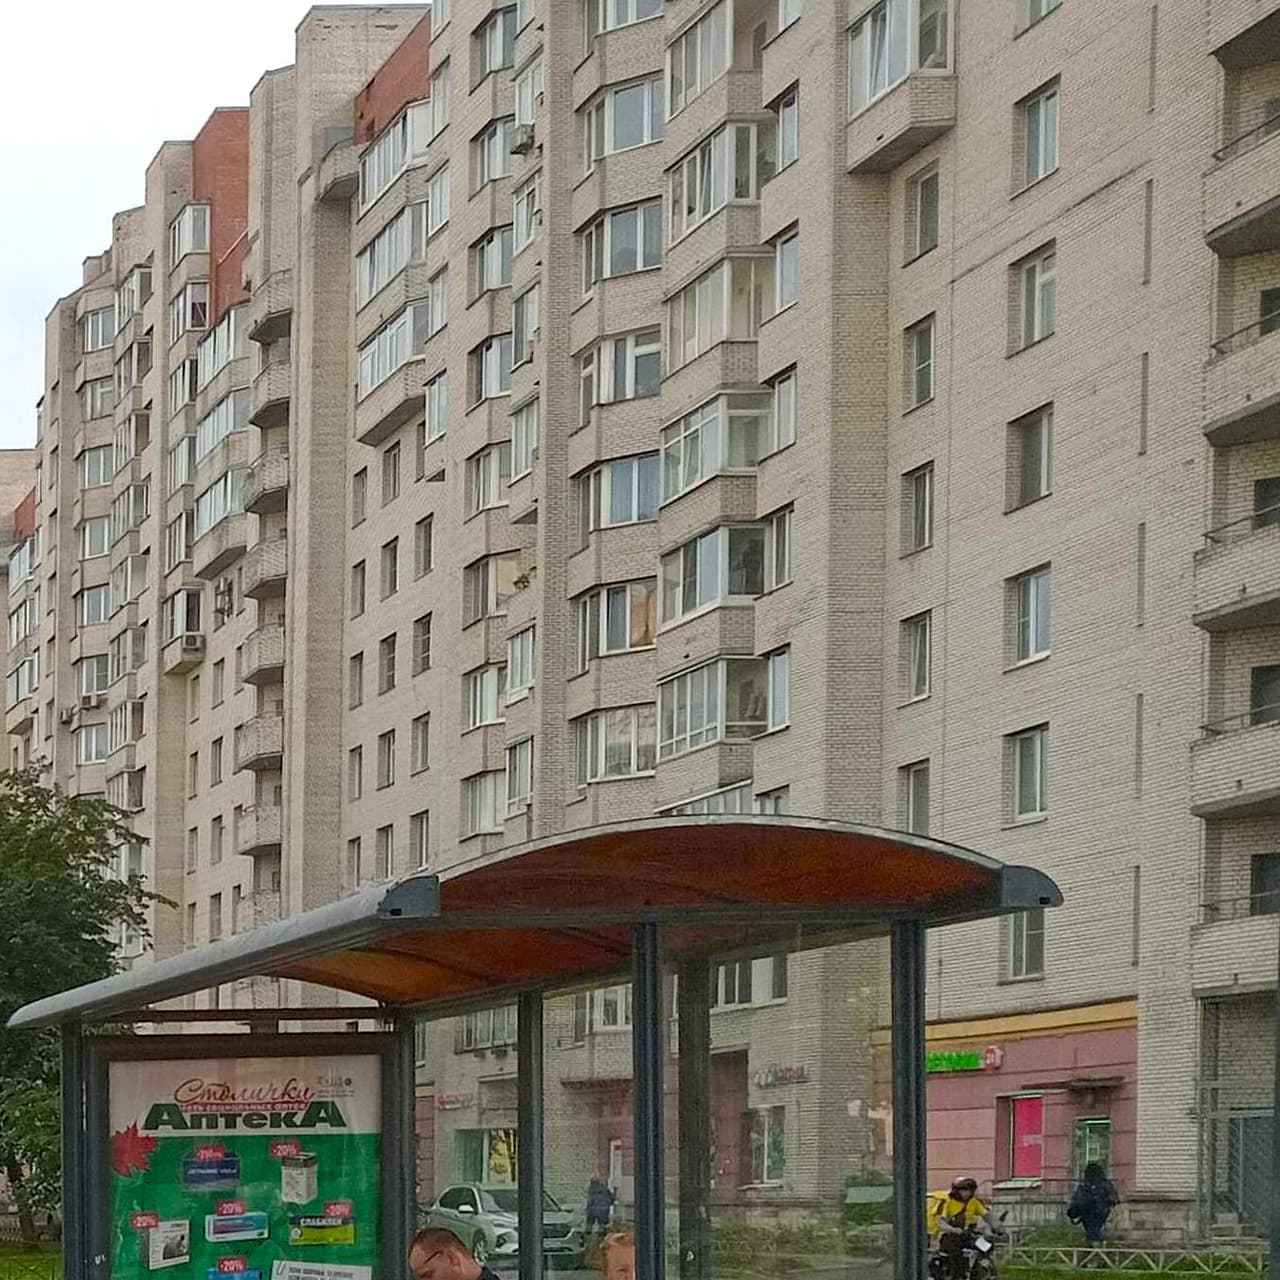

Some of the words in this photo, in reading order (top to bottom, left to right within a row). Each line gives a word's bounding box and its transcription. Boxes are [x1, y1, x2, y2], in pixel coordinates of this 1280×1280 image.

[174, 1078, 315, 1103] Столички
[218, 1202, 244, 1215] -20%
[220, 1259, 245, 1272] -20%
